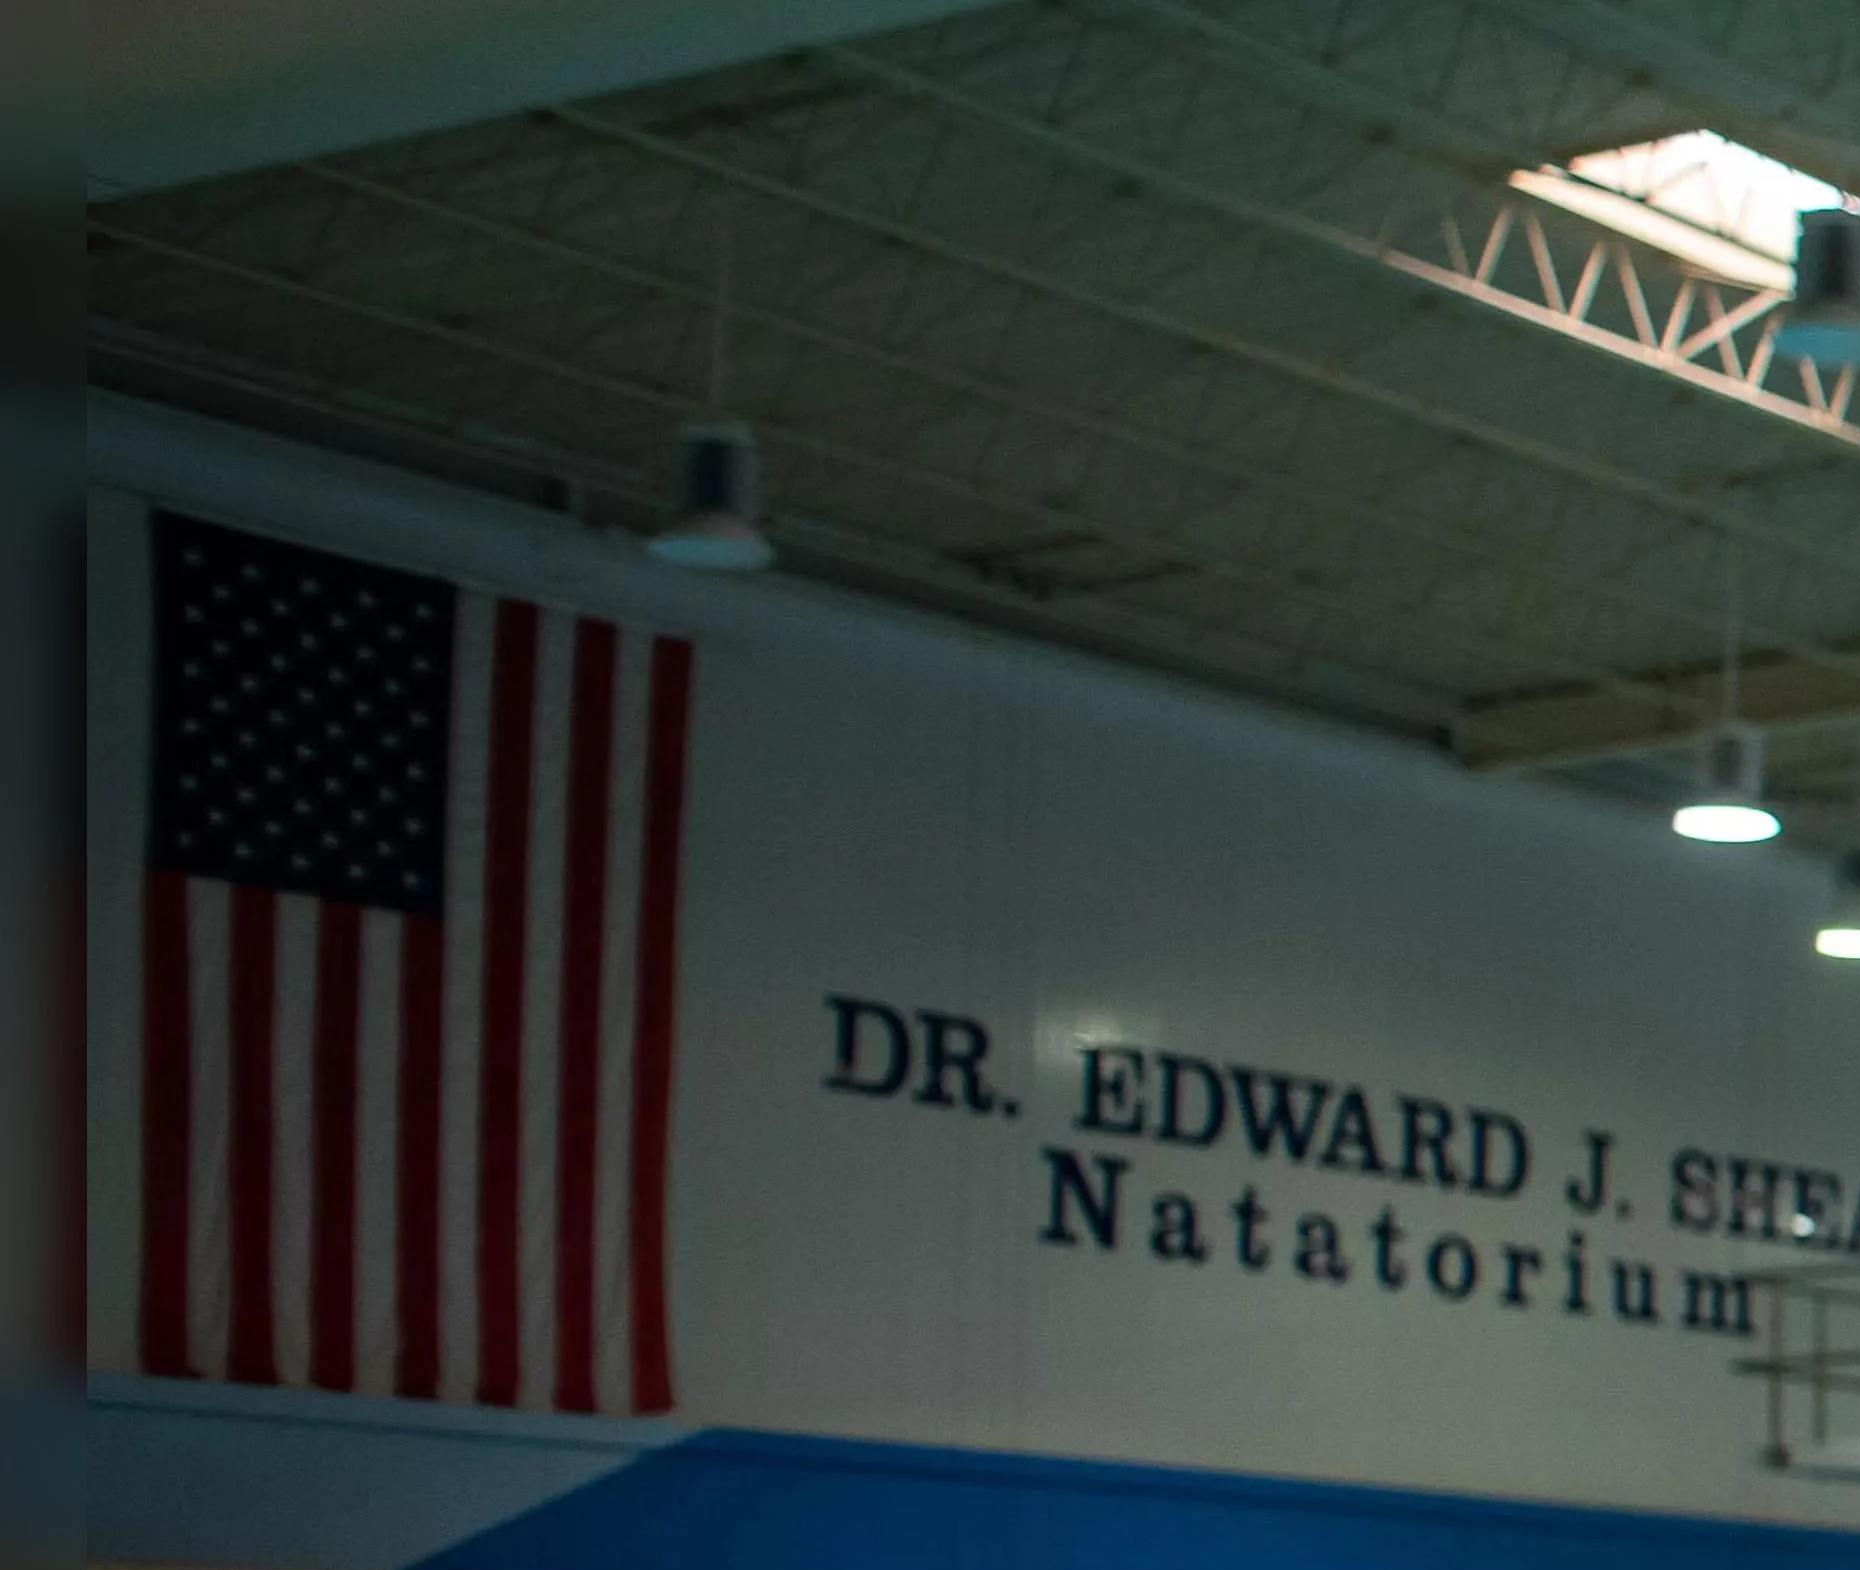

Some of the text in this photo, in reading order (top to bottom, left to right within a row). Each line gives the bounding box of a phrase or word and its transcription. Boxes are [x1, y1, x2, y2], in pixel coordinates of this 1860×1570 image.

[822, 994, 1020, 1118] DR.
[1072, 1042, 1530, 1200] EDWARD
[1565, 1131, 1633, 1221] J.
[1038, 1147, 1756, 1337] Natatorium
